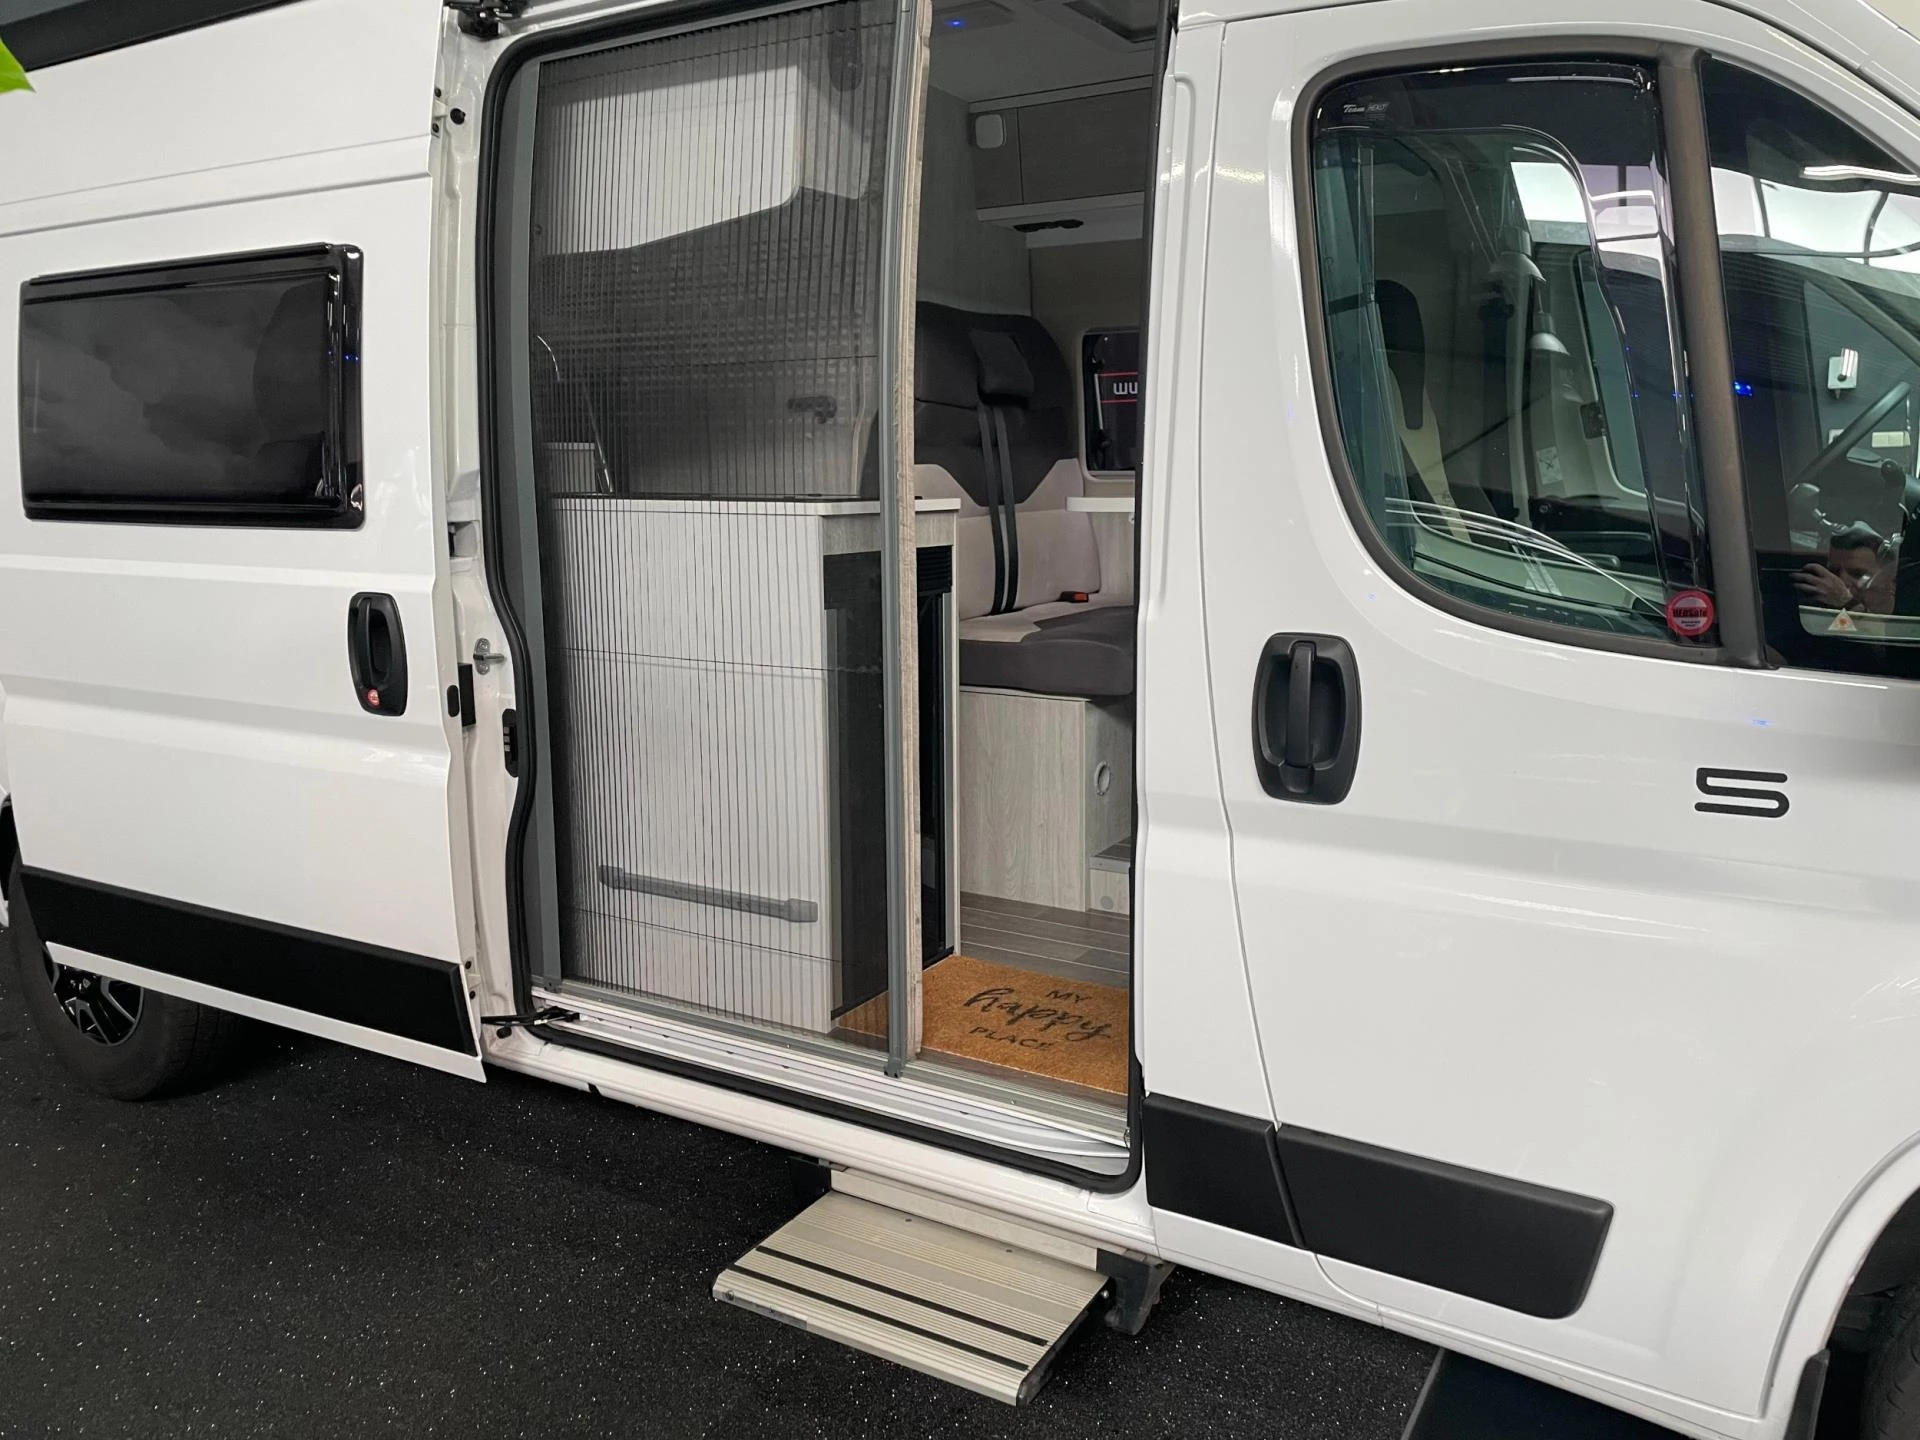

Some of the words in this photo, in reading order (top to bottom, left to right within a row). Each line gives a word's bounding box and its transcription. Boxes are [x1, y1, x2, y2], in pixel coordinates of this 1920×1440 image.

[1694, 767, 1790, 818] S
[963, 987, 1112, 1042] happy
[1046, 989, 1092, 1004] MY
[969, 1026, 1053, 1050] PLACE
